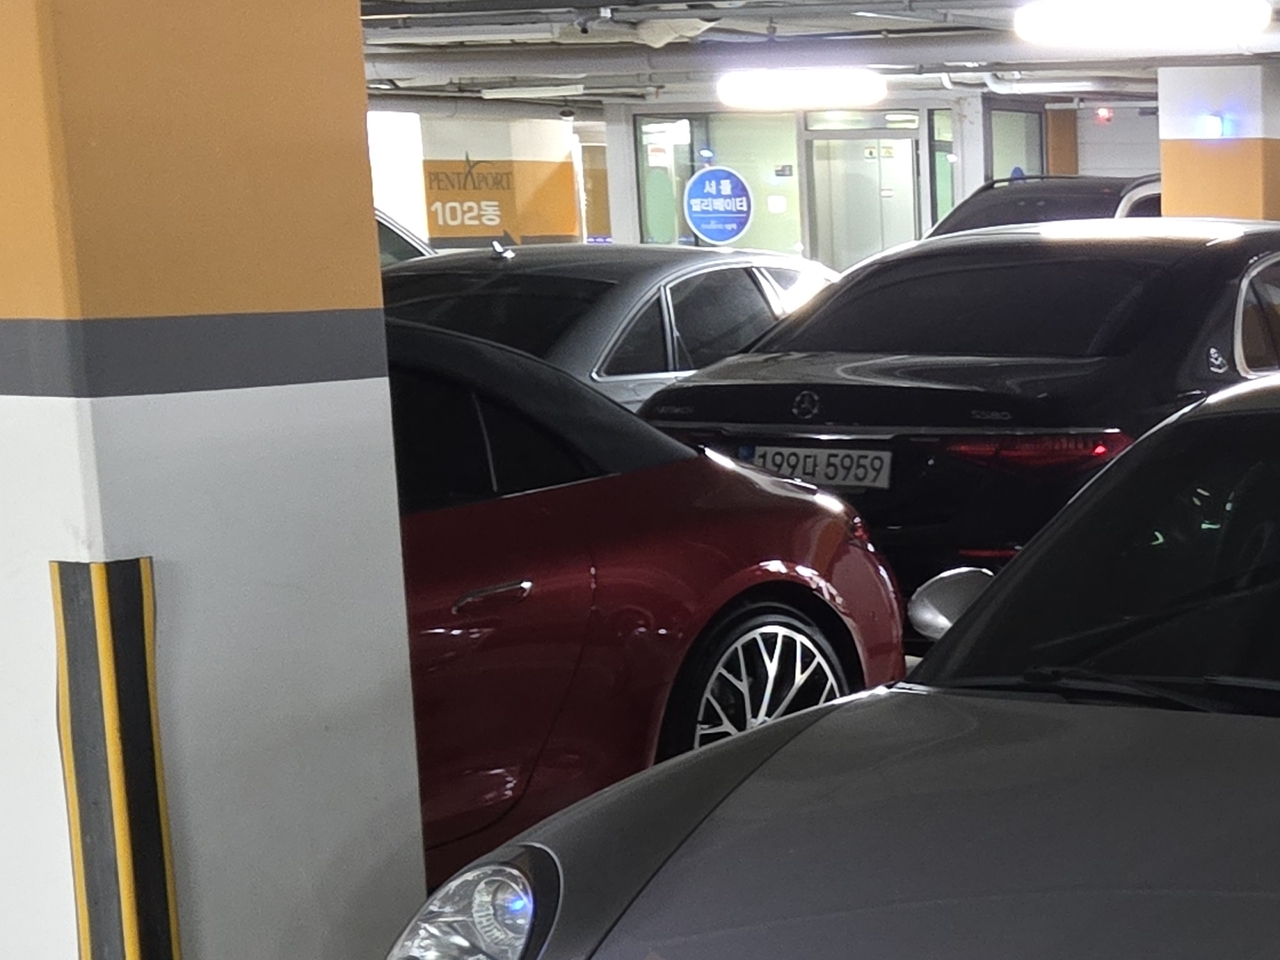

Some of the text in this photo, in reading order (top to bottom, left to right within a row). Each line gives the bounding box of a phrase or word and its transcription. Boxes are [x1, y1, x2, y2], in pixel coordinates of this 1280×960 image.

[428, 160, 512, 190] PENTAPORT
[431, 201, 501, 226] 102동
[690, 196, 747, 211] 엘리베이터
[824, 454, 884, 483] 5959
